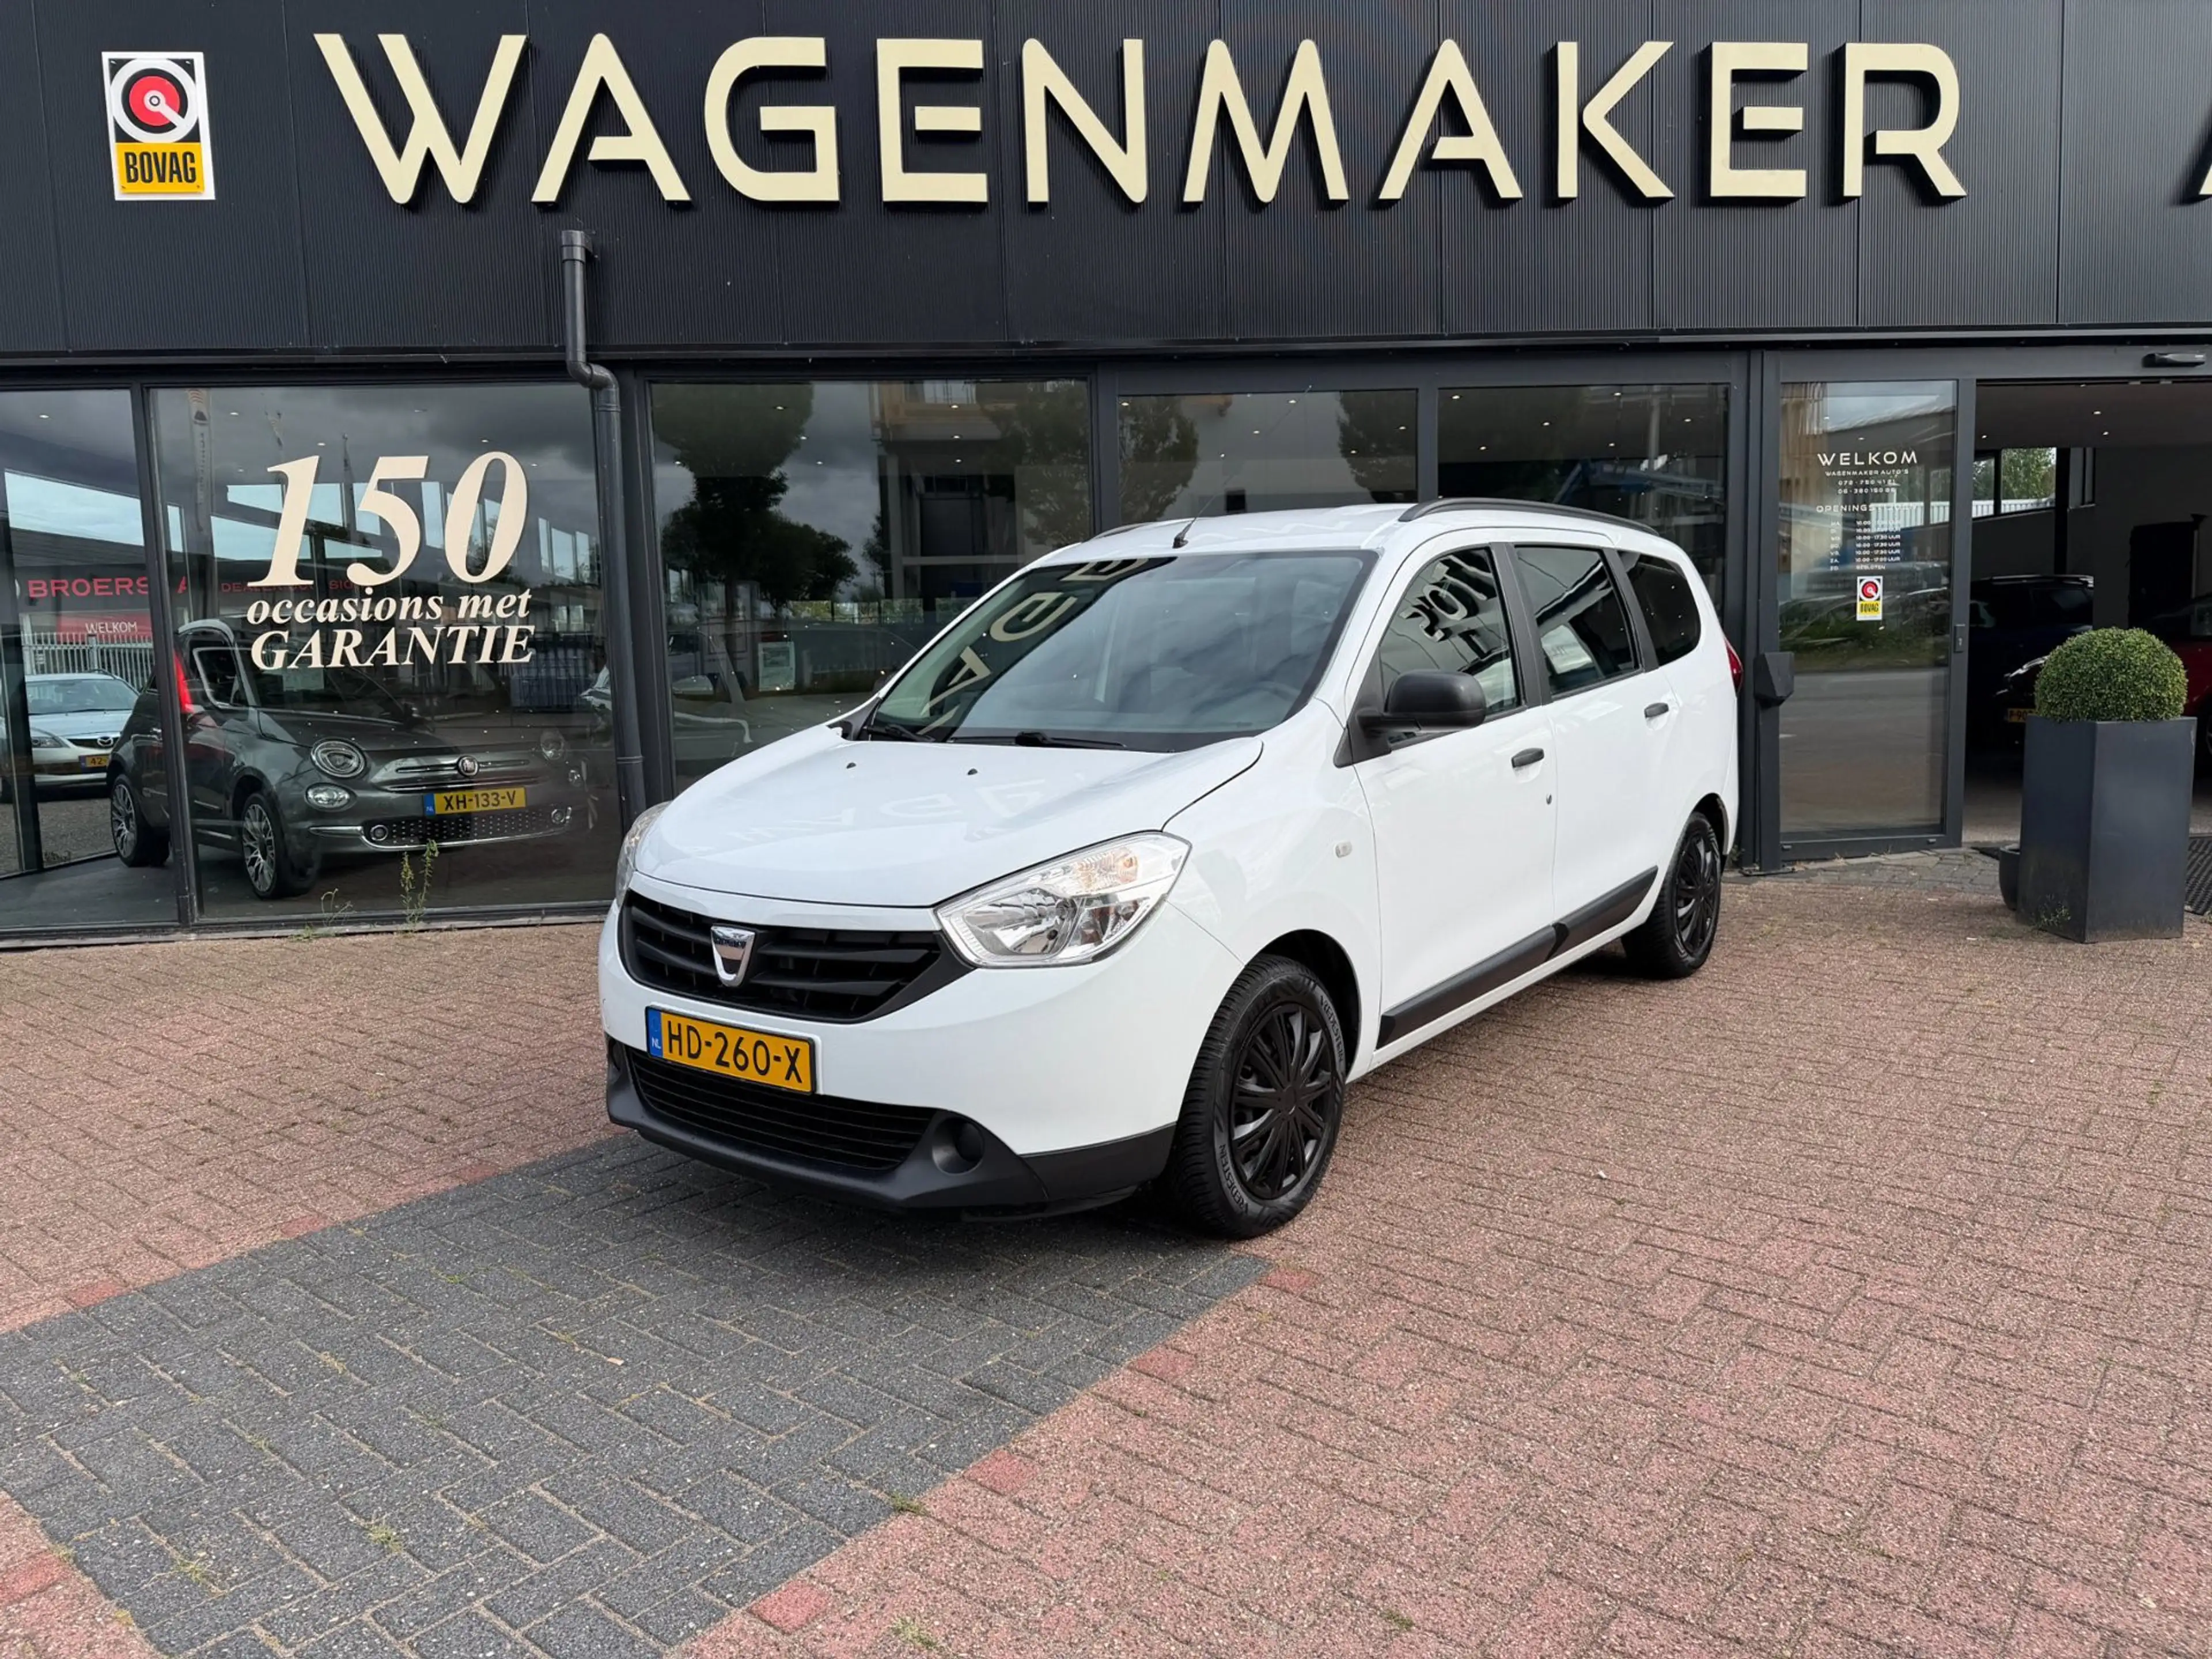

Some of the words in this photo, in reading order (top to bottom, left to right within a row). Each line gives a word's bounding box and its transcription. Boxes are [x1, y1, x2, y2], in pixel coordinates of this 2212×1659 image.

[313, 33, 1967, 204] WAGENMAKER
[124, 151, 197, 183] BOVAG
[1817, 450, 1918, 467] WELKOM
[247, 450, 528, 587] 150
[28, 576, 148, 598] BROERS
[246, 586, 444, 626] occasions
[457, 588, 533, 619] met
[85, 621, 138, 634] WELKOM
[251, 624, 535, 671] GARANTIE
[443, 790, 517, 811] XH-133-V
[652, 1037, 661, 1049] NL
[667, 1020, 803, 1084] HD-260-X
